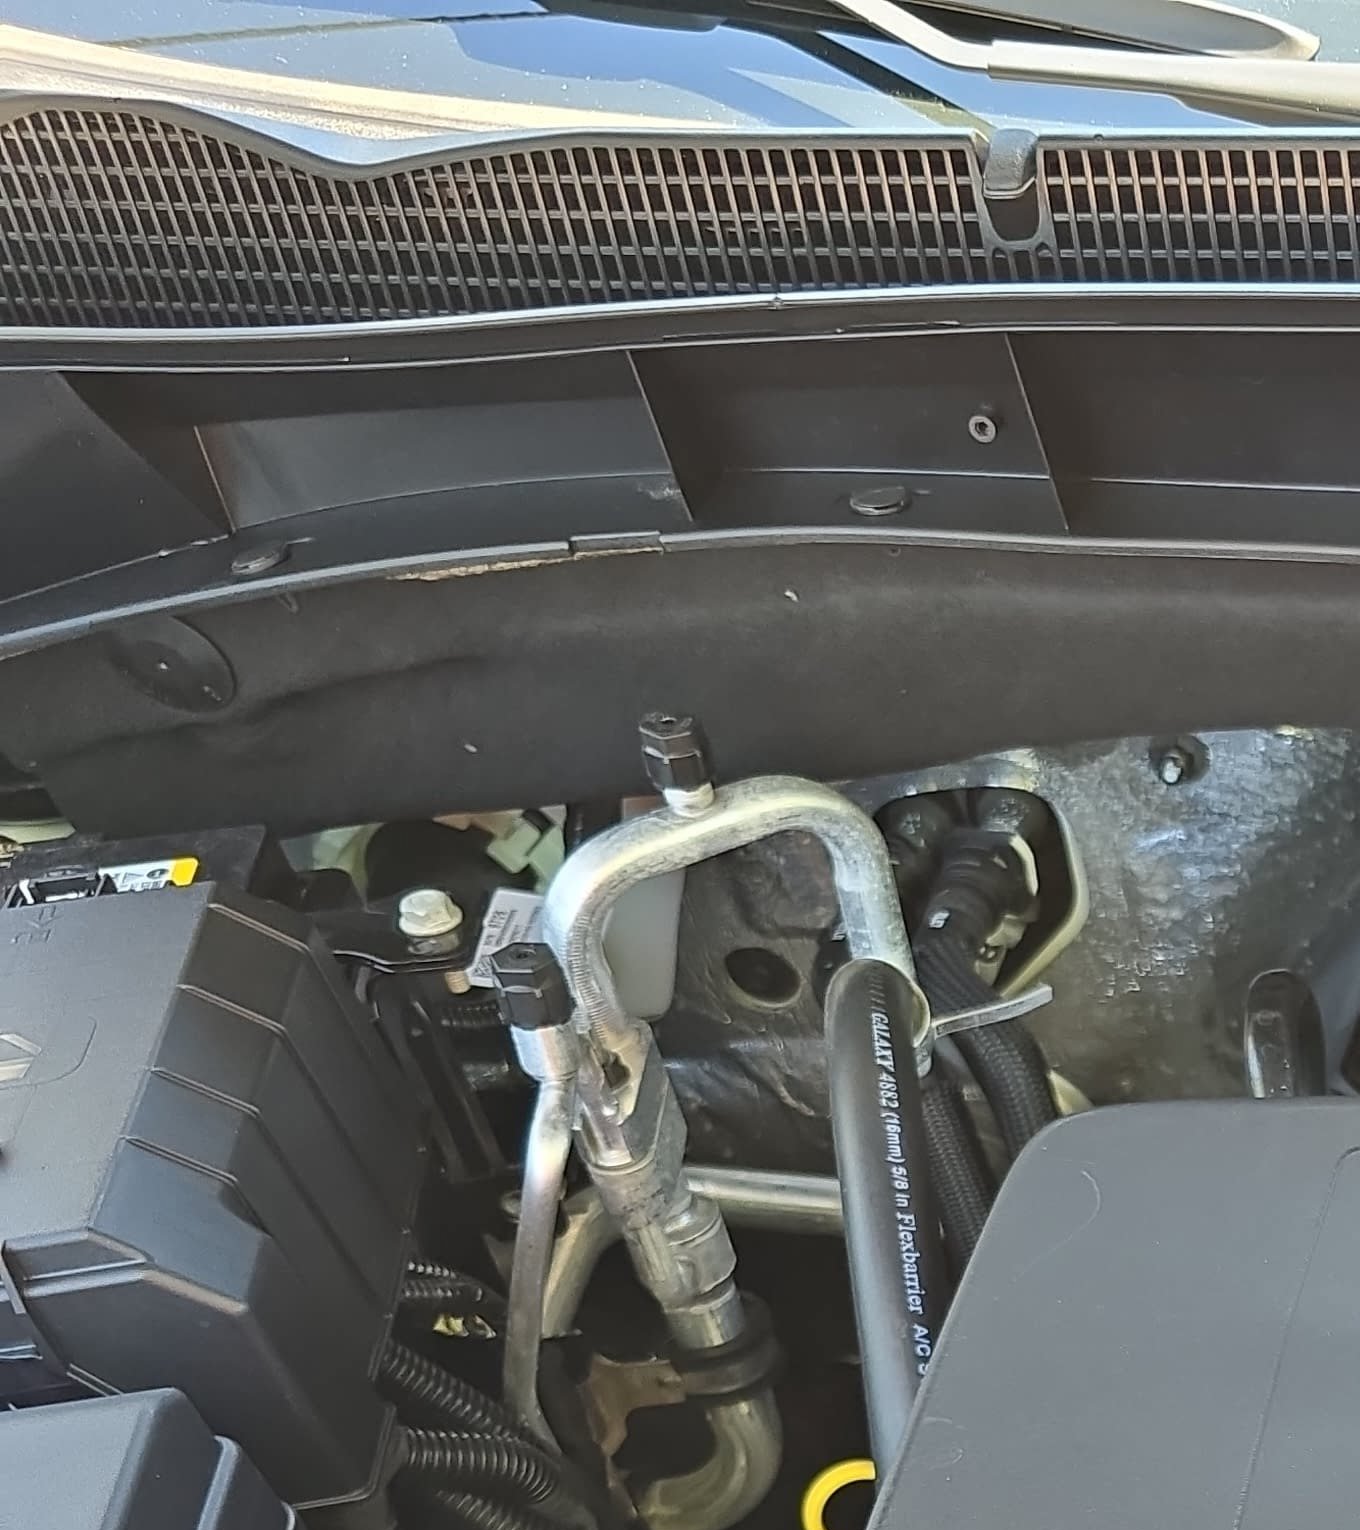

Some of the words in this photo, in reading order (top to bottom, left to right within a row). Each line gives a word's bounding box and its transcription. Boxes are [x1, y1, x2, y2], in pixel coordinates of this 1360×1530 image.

[870, 1012, 895, 1073] GALAXY
[877, 1072, 900, 1109] 4882
[880, 1109, 906, 1163] (16mm)
[889, 1164, 910, 1192] 5/8
[895, 1211, 926, 1316] Flexbarrier
[912, 1323, 932, 1357] A/C
